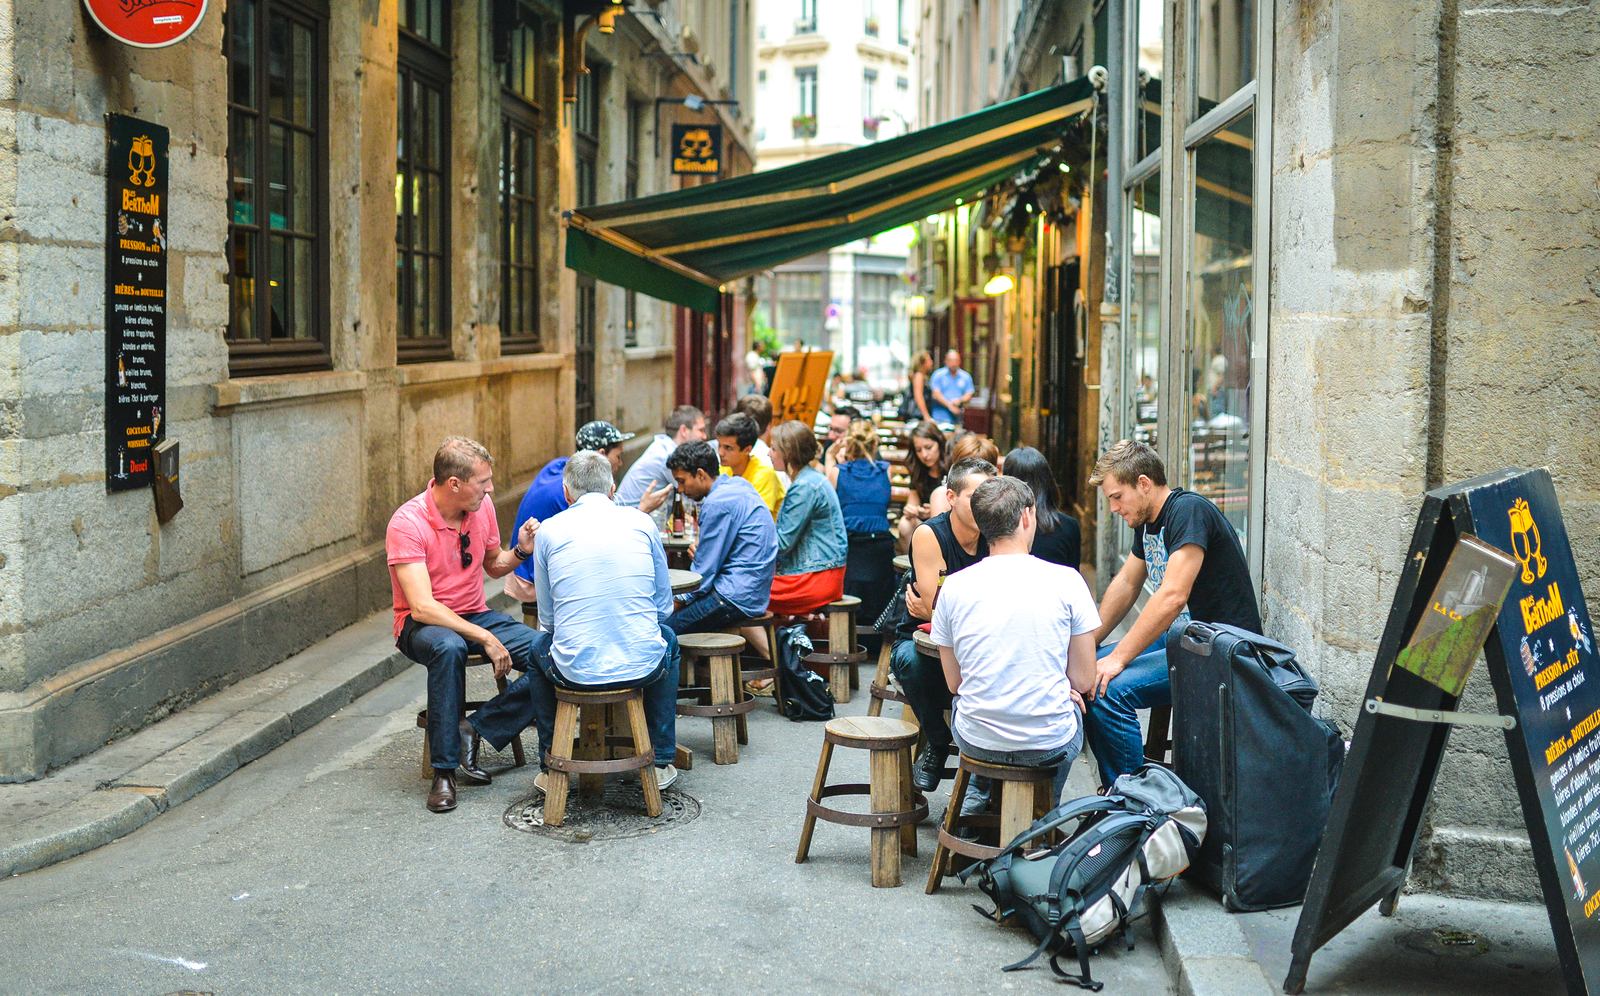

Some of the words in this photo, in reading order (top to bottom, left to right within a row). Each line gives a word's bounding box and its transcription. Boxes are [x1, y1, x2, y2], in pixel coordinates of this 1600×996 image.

[120, 240, 145, 251] PRESSION
[126, 257, 142, 265] pressions
[114, 283, 134, 294] BIÈRES
[130, 458, 148, 473] Duvel
[1534, 660, 1562, 692] PRESSION
[1567, 648, 1580, 668] FÛT
[1546, 684, 1566, 710] pressions
[1566, 680, 1572, 692] au
[1572, 670, 1586, 688] choix
[1546, 736, 1568, 766] BIÈRES
[1568, 756, 1574, 772] et
[1556, 786, 1570, 807] bières
[1578, 796, 1584, 811] et
[1568, 821, 1586, 844] vieilles
[1576, 842, 1591, 864] bières
